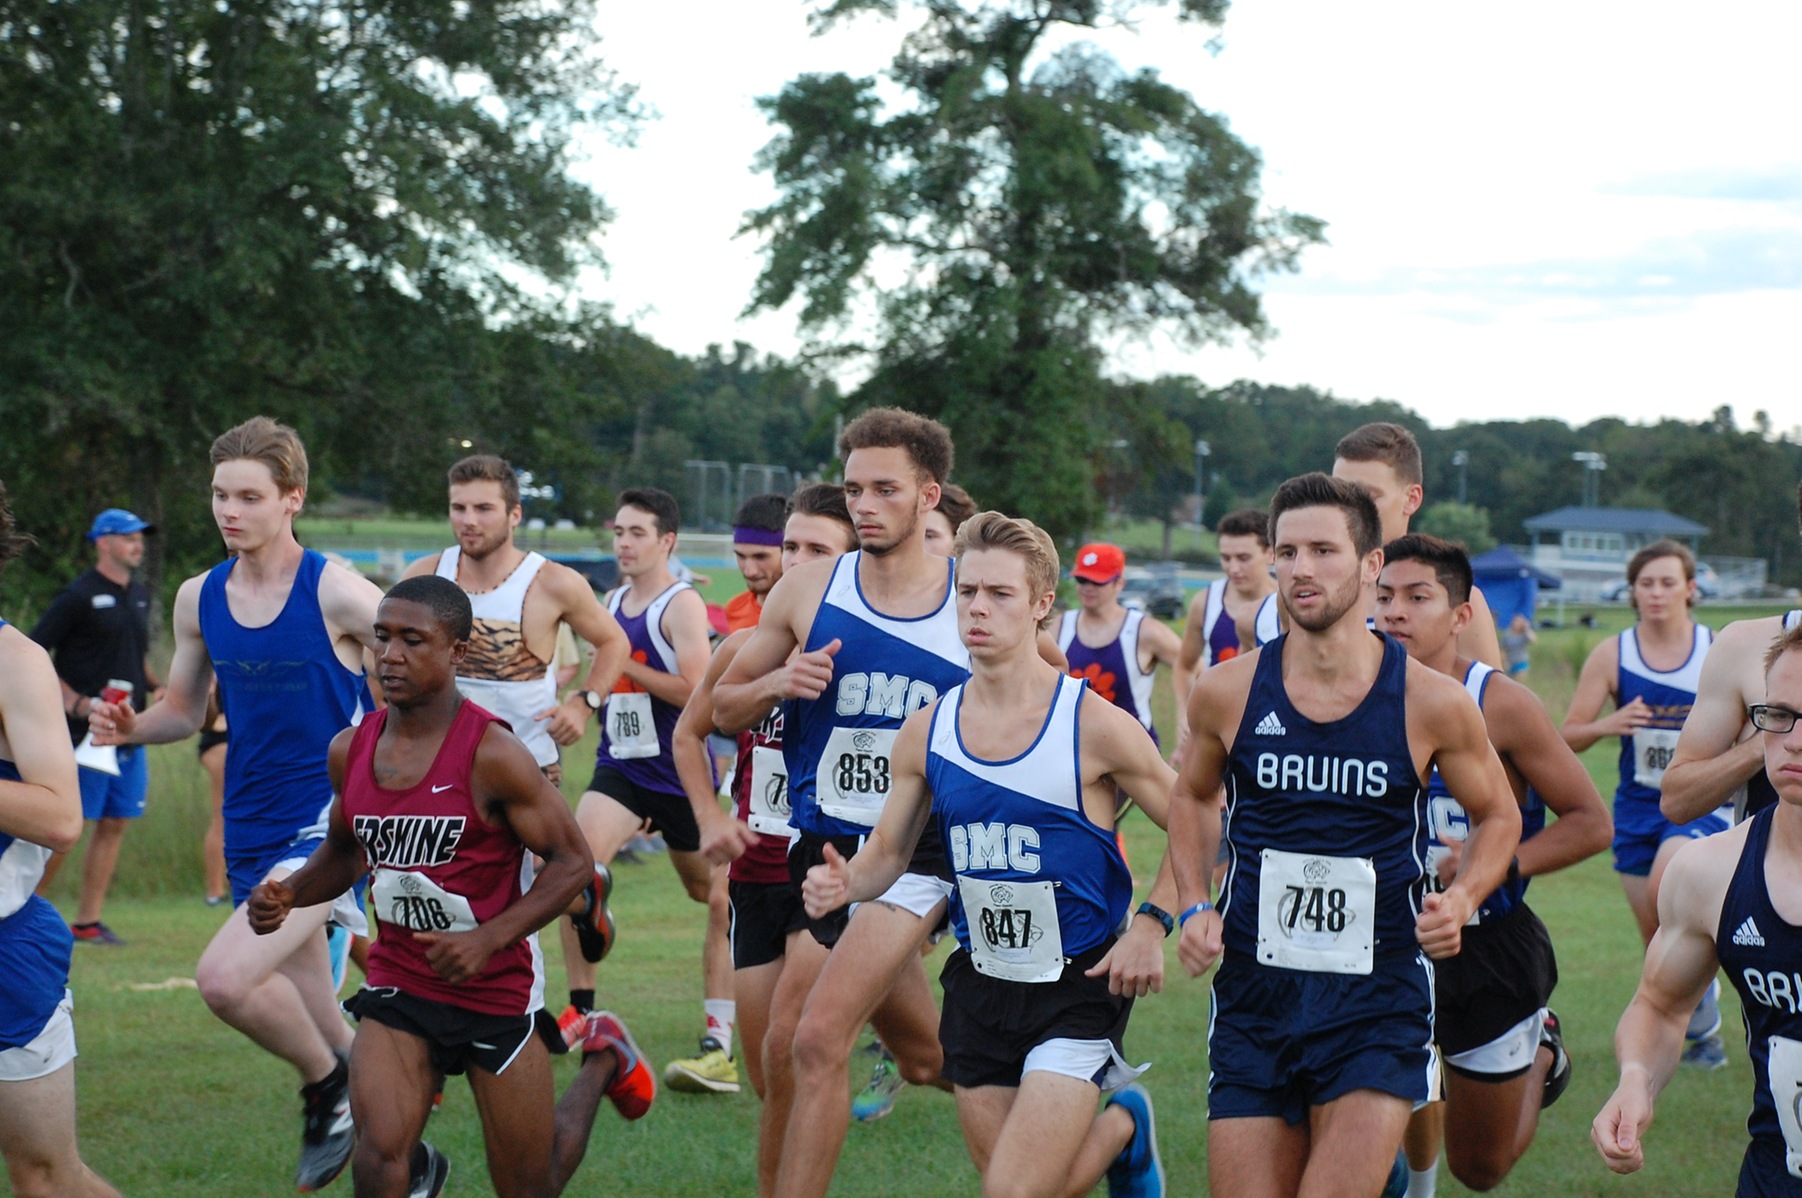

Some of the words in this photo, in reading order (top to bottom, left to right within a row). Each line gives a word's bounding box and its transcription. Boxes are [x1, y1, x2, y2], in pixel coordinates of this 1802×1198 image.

[836, 672, 938, 719] SMC
[616, 711, 640, 737] 789
[1255, 726, 1286, 736] adidas
[839, 753, 889, 793] 853
[1257, 752, 1388, 797] BRUINS
[950, 822, 1041, 874] SMC
[393, 896, 452, 932] 706
[982, 907, 1031, 948] 847
[1286, 885, 1345, 932] 748
[1732, 934, 1766, 947] adidas
